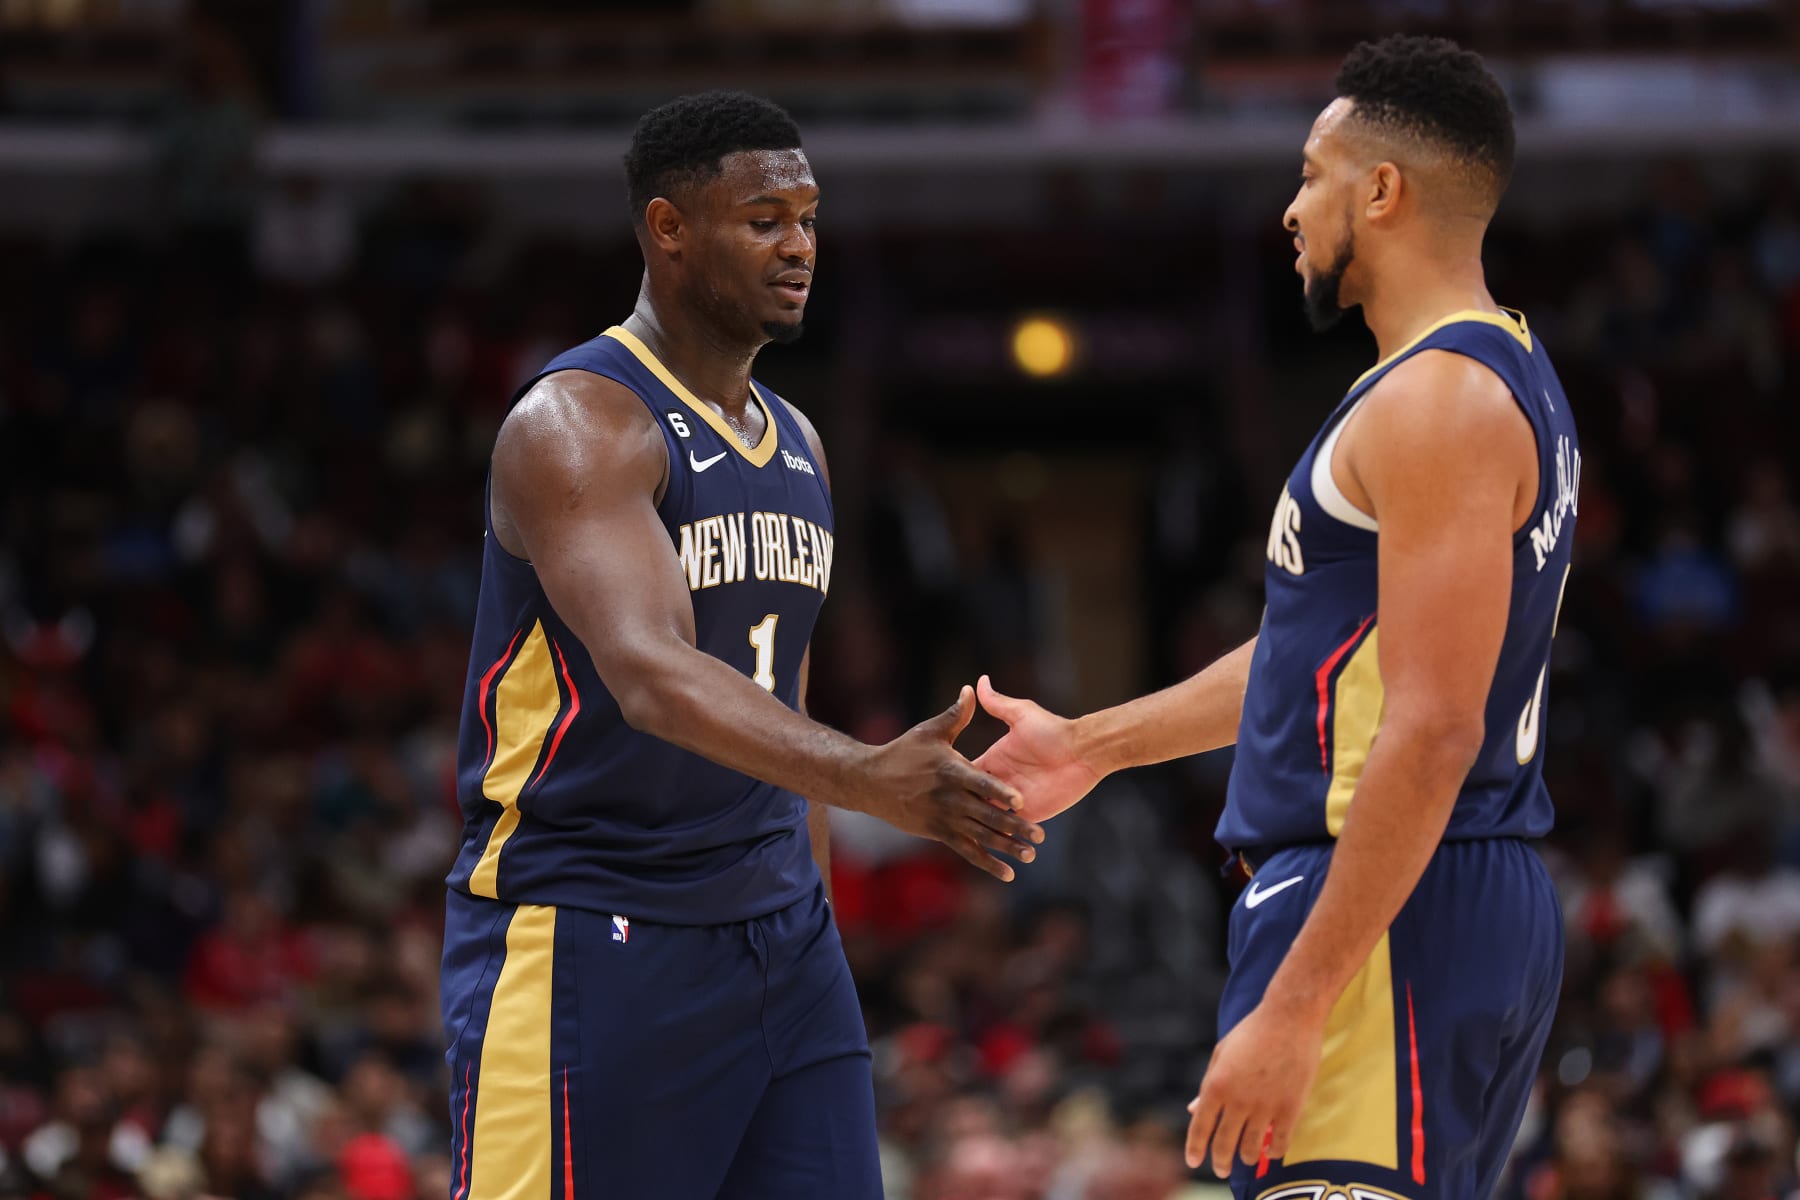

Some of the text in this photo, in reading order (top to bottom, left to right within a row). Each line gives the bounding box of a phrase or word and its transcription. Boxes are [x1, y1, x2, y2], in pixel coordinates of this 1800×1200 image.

[667, 412, 691, 438] 6
[780, 449, 815, 475] ibotta
[679, 512, 747, 590] NEW
[749, 613, 779, 693] 1
